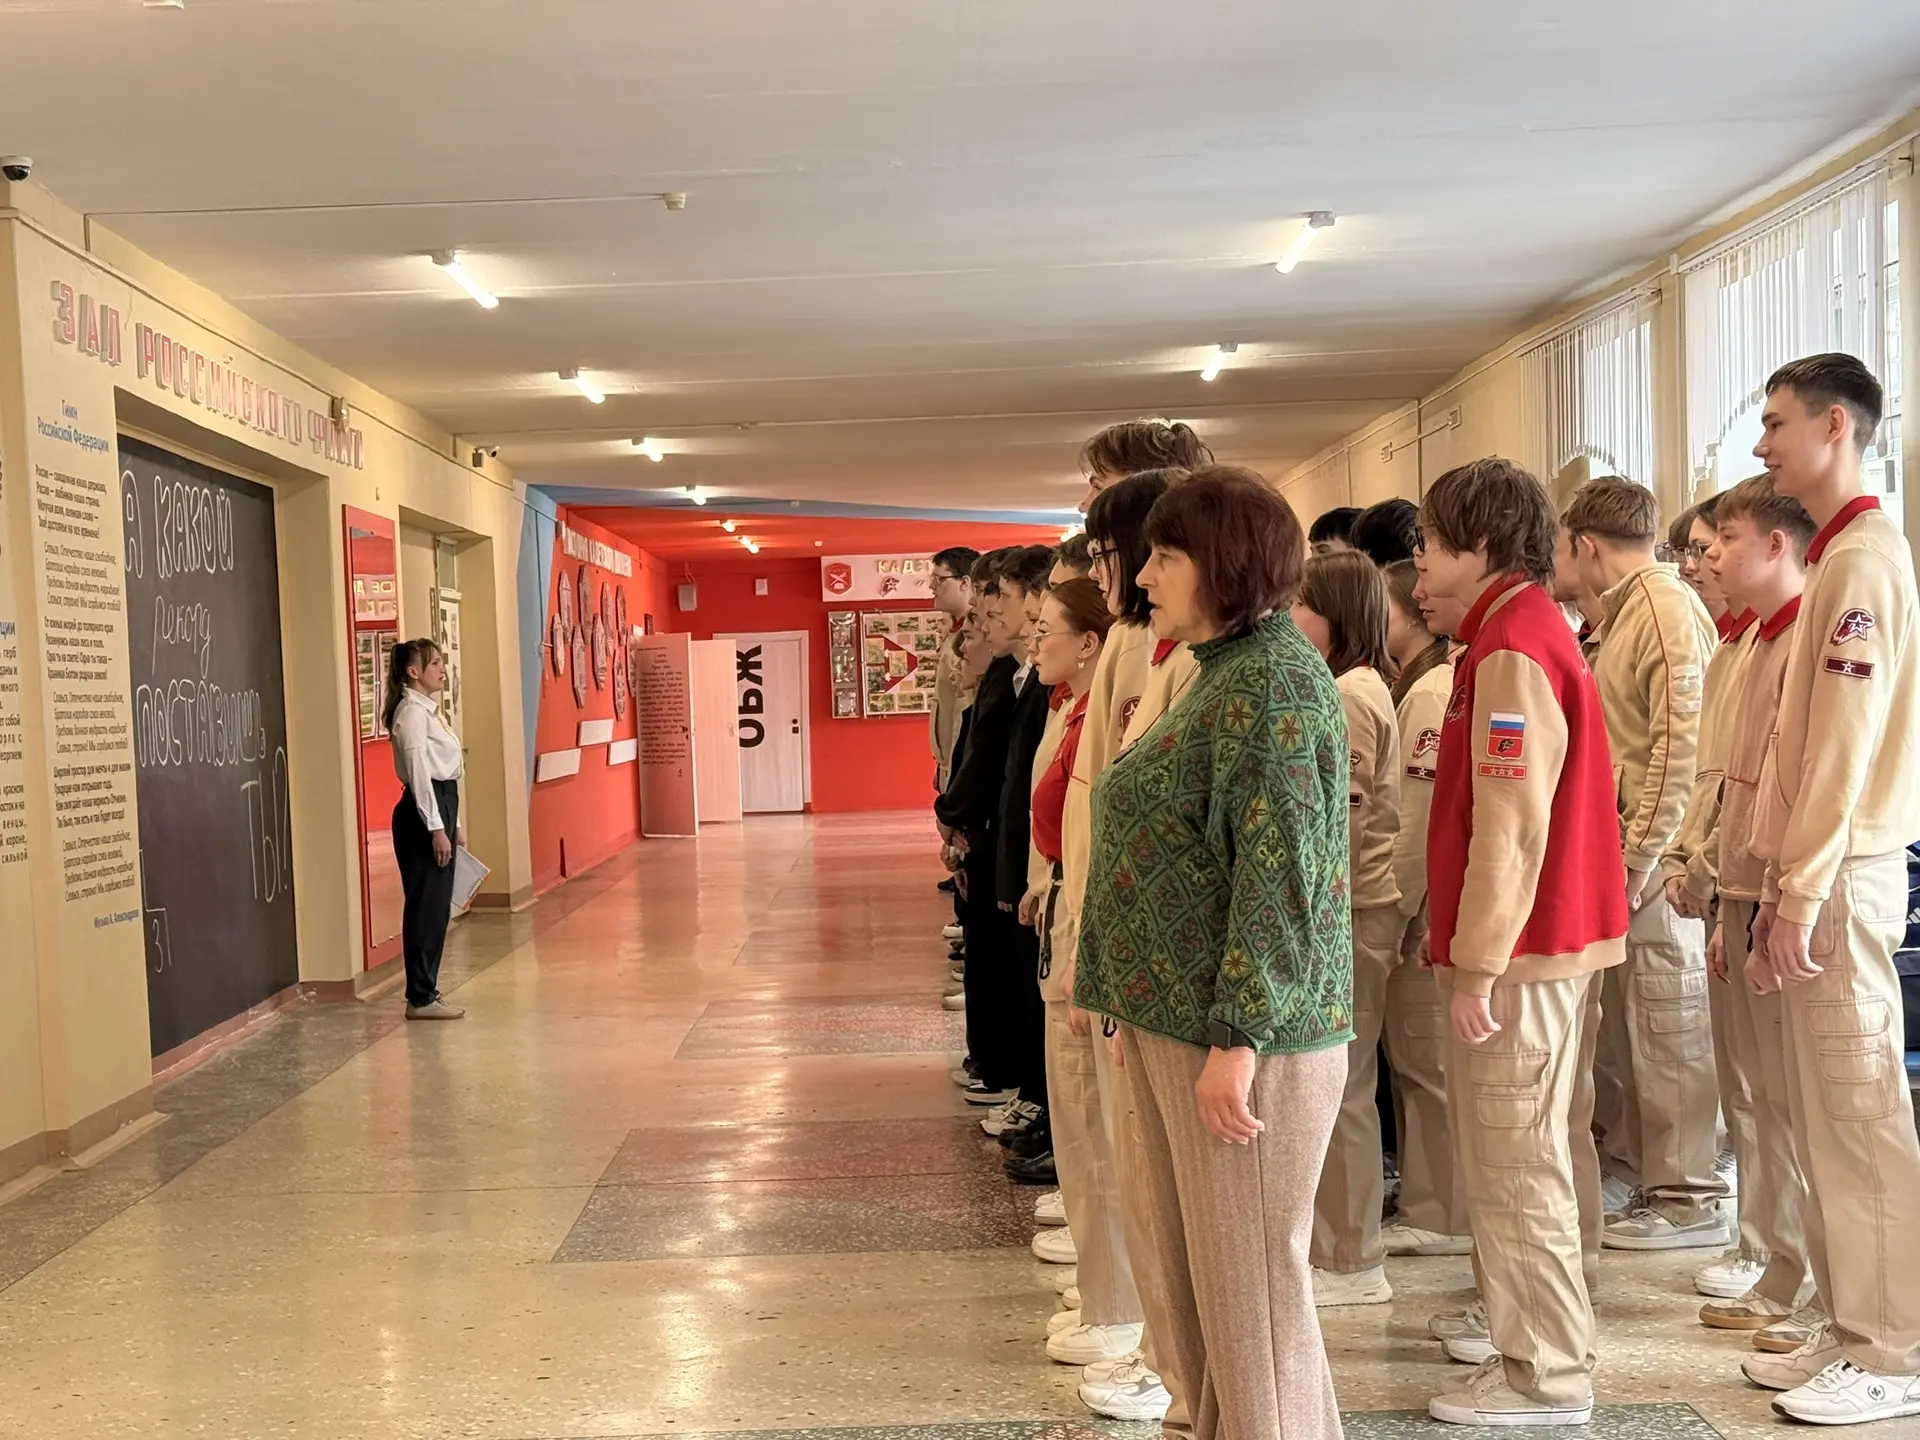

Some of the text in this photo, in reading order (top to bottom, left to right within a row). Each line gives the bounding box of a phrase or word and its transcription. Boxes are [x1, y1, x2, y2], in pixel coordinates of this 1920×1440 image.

[52, 280, 122, 366] ЗАЛ
[135, 322, 302, 444] РОССИЙСКОГО
[37, 415, 73, 443] Российской
